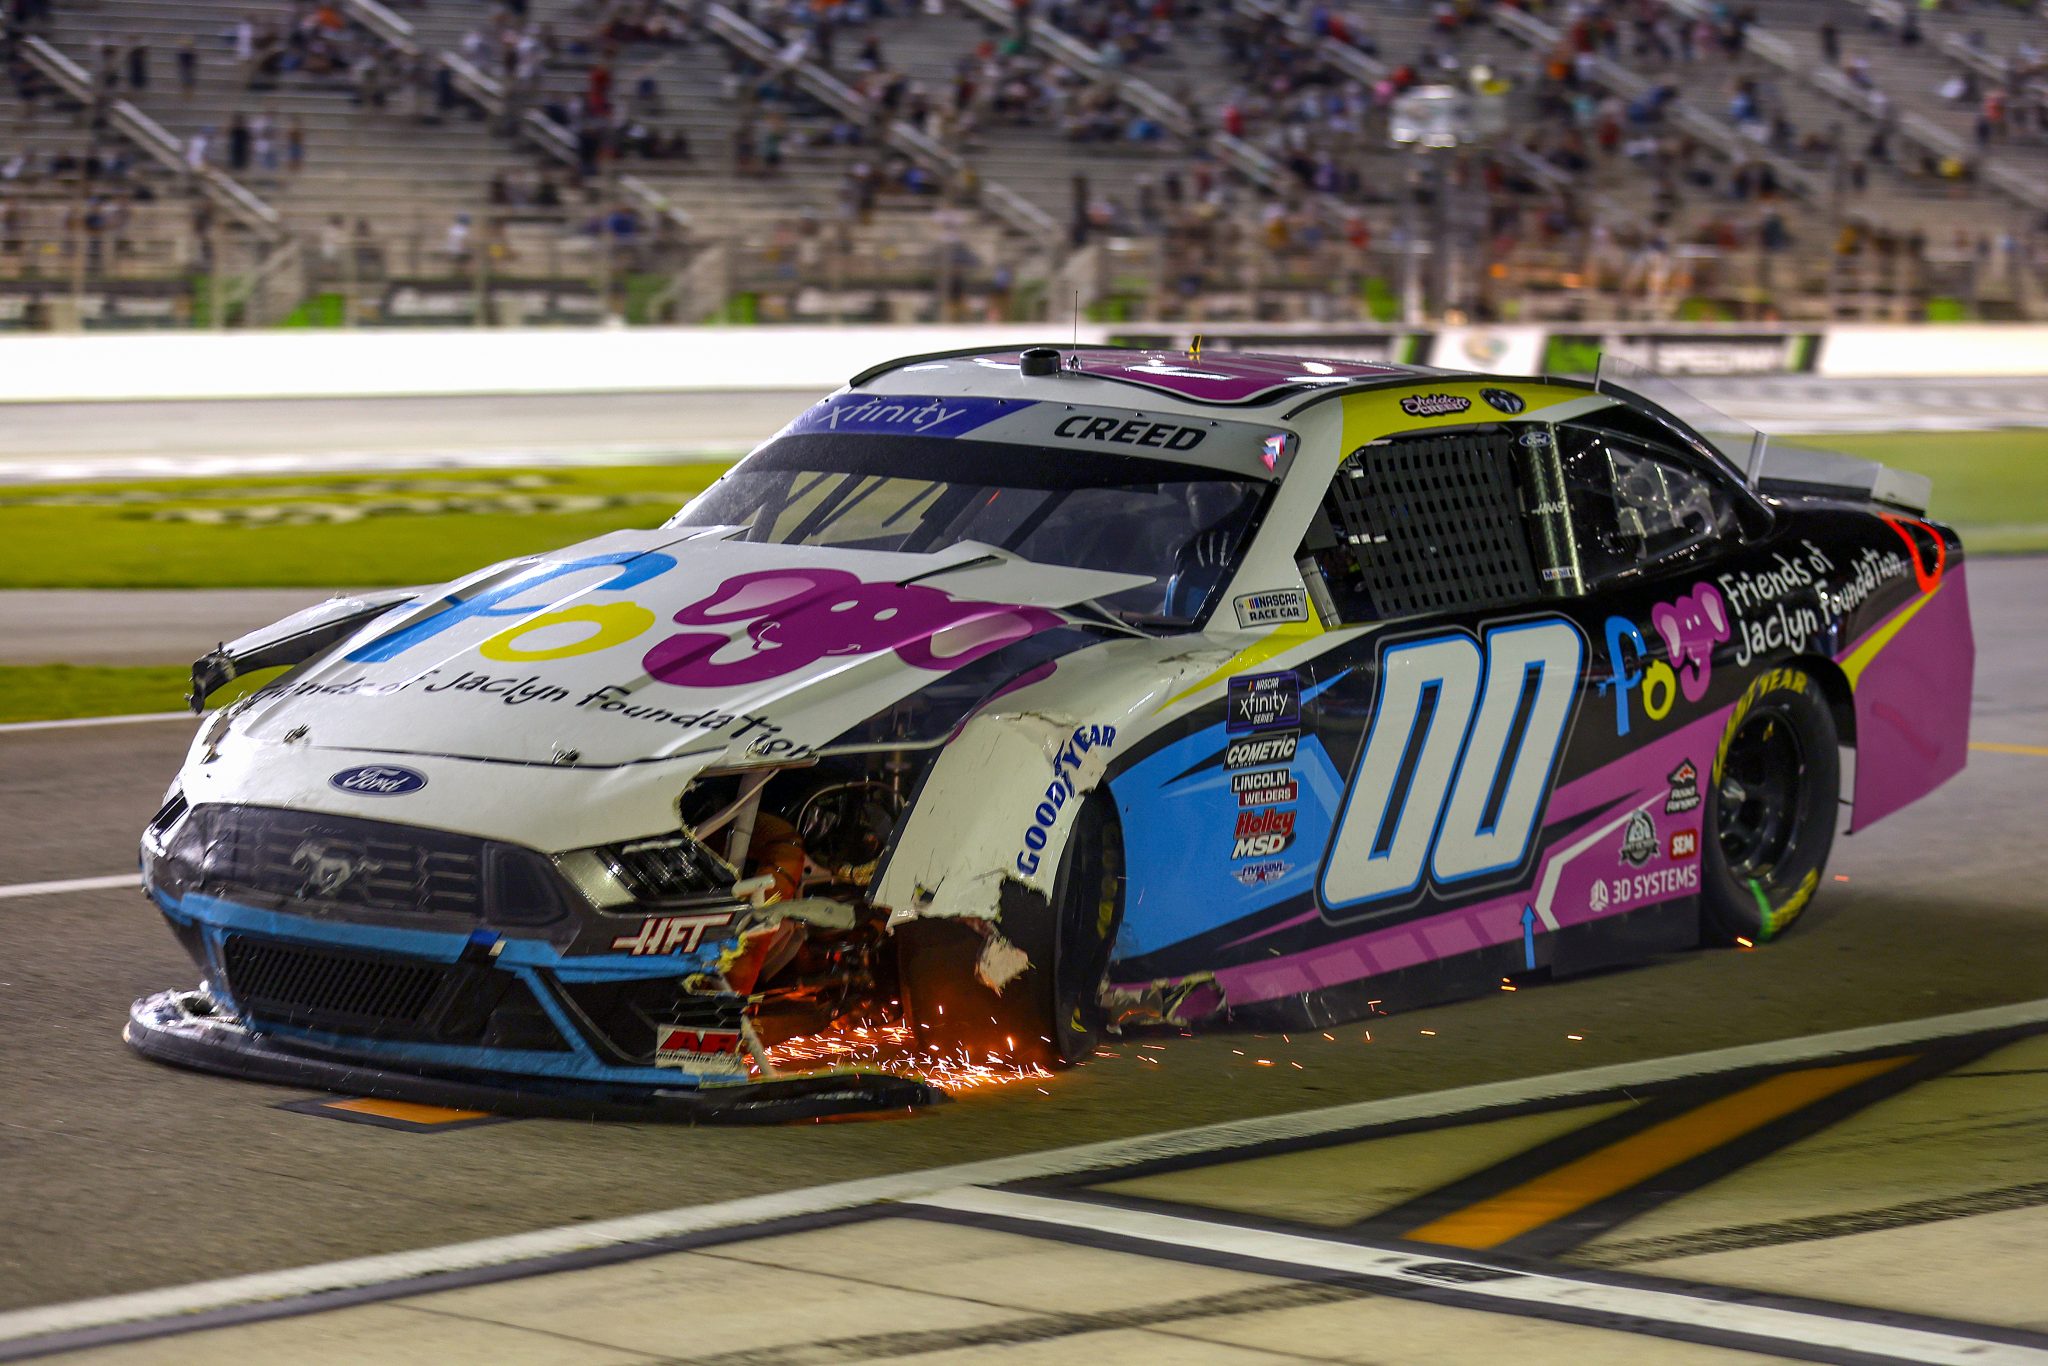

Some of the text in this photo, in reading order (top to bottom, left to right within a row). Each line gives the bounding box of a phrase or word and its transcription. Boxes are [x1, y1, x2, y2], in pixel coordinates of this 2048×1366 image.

[817, 401, 966, 433] xfinity
[1054, 415, 1207, 451] CREED
[1717, 539, 1835, 616] Friends of
[1249, 607, 1299, 621] RACE CAR
[1259, 593, 1298, 609] NASCAR
[1734, 603, 1819, 667] Jaclyn
[424, 670, 570, 706] Jaclyn
[1256, 677, 1279, 691] NASCAR
[1240, 690, 1288, 720] xfinity
[1253, 712, 1275, 725] SERIES
[1227, 735, 1296, 766] COMETIC
[1321, 618, 1583, 911] 00
[342, 766, 411, 792] Ford
[1233, 771, 1287, 792] LINCOLN
[1016, 724, 1117, 877] GOODYEAR
[1244, 787, 1291, 805] WELDERS
[1235, 807, 1297, 838] Holley
[1231, 834, 1286, 860] MSD
[1672, 832, 1694, 856] SEM
[1612, 864, 1698, 905] 3D SYSTEMS
